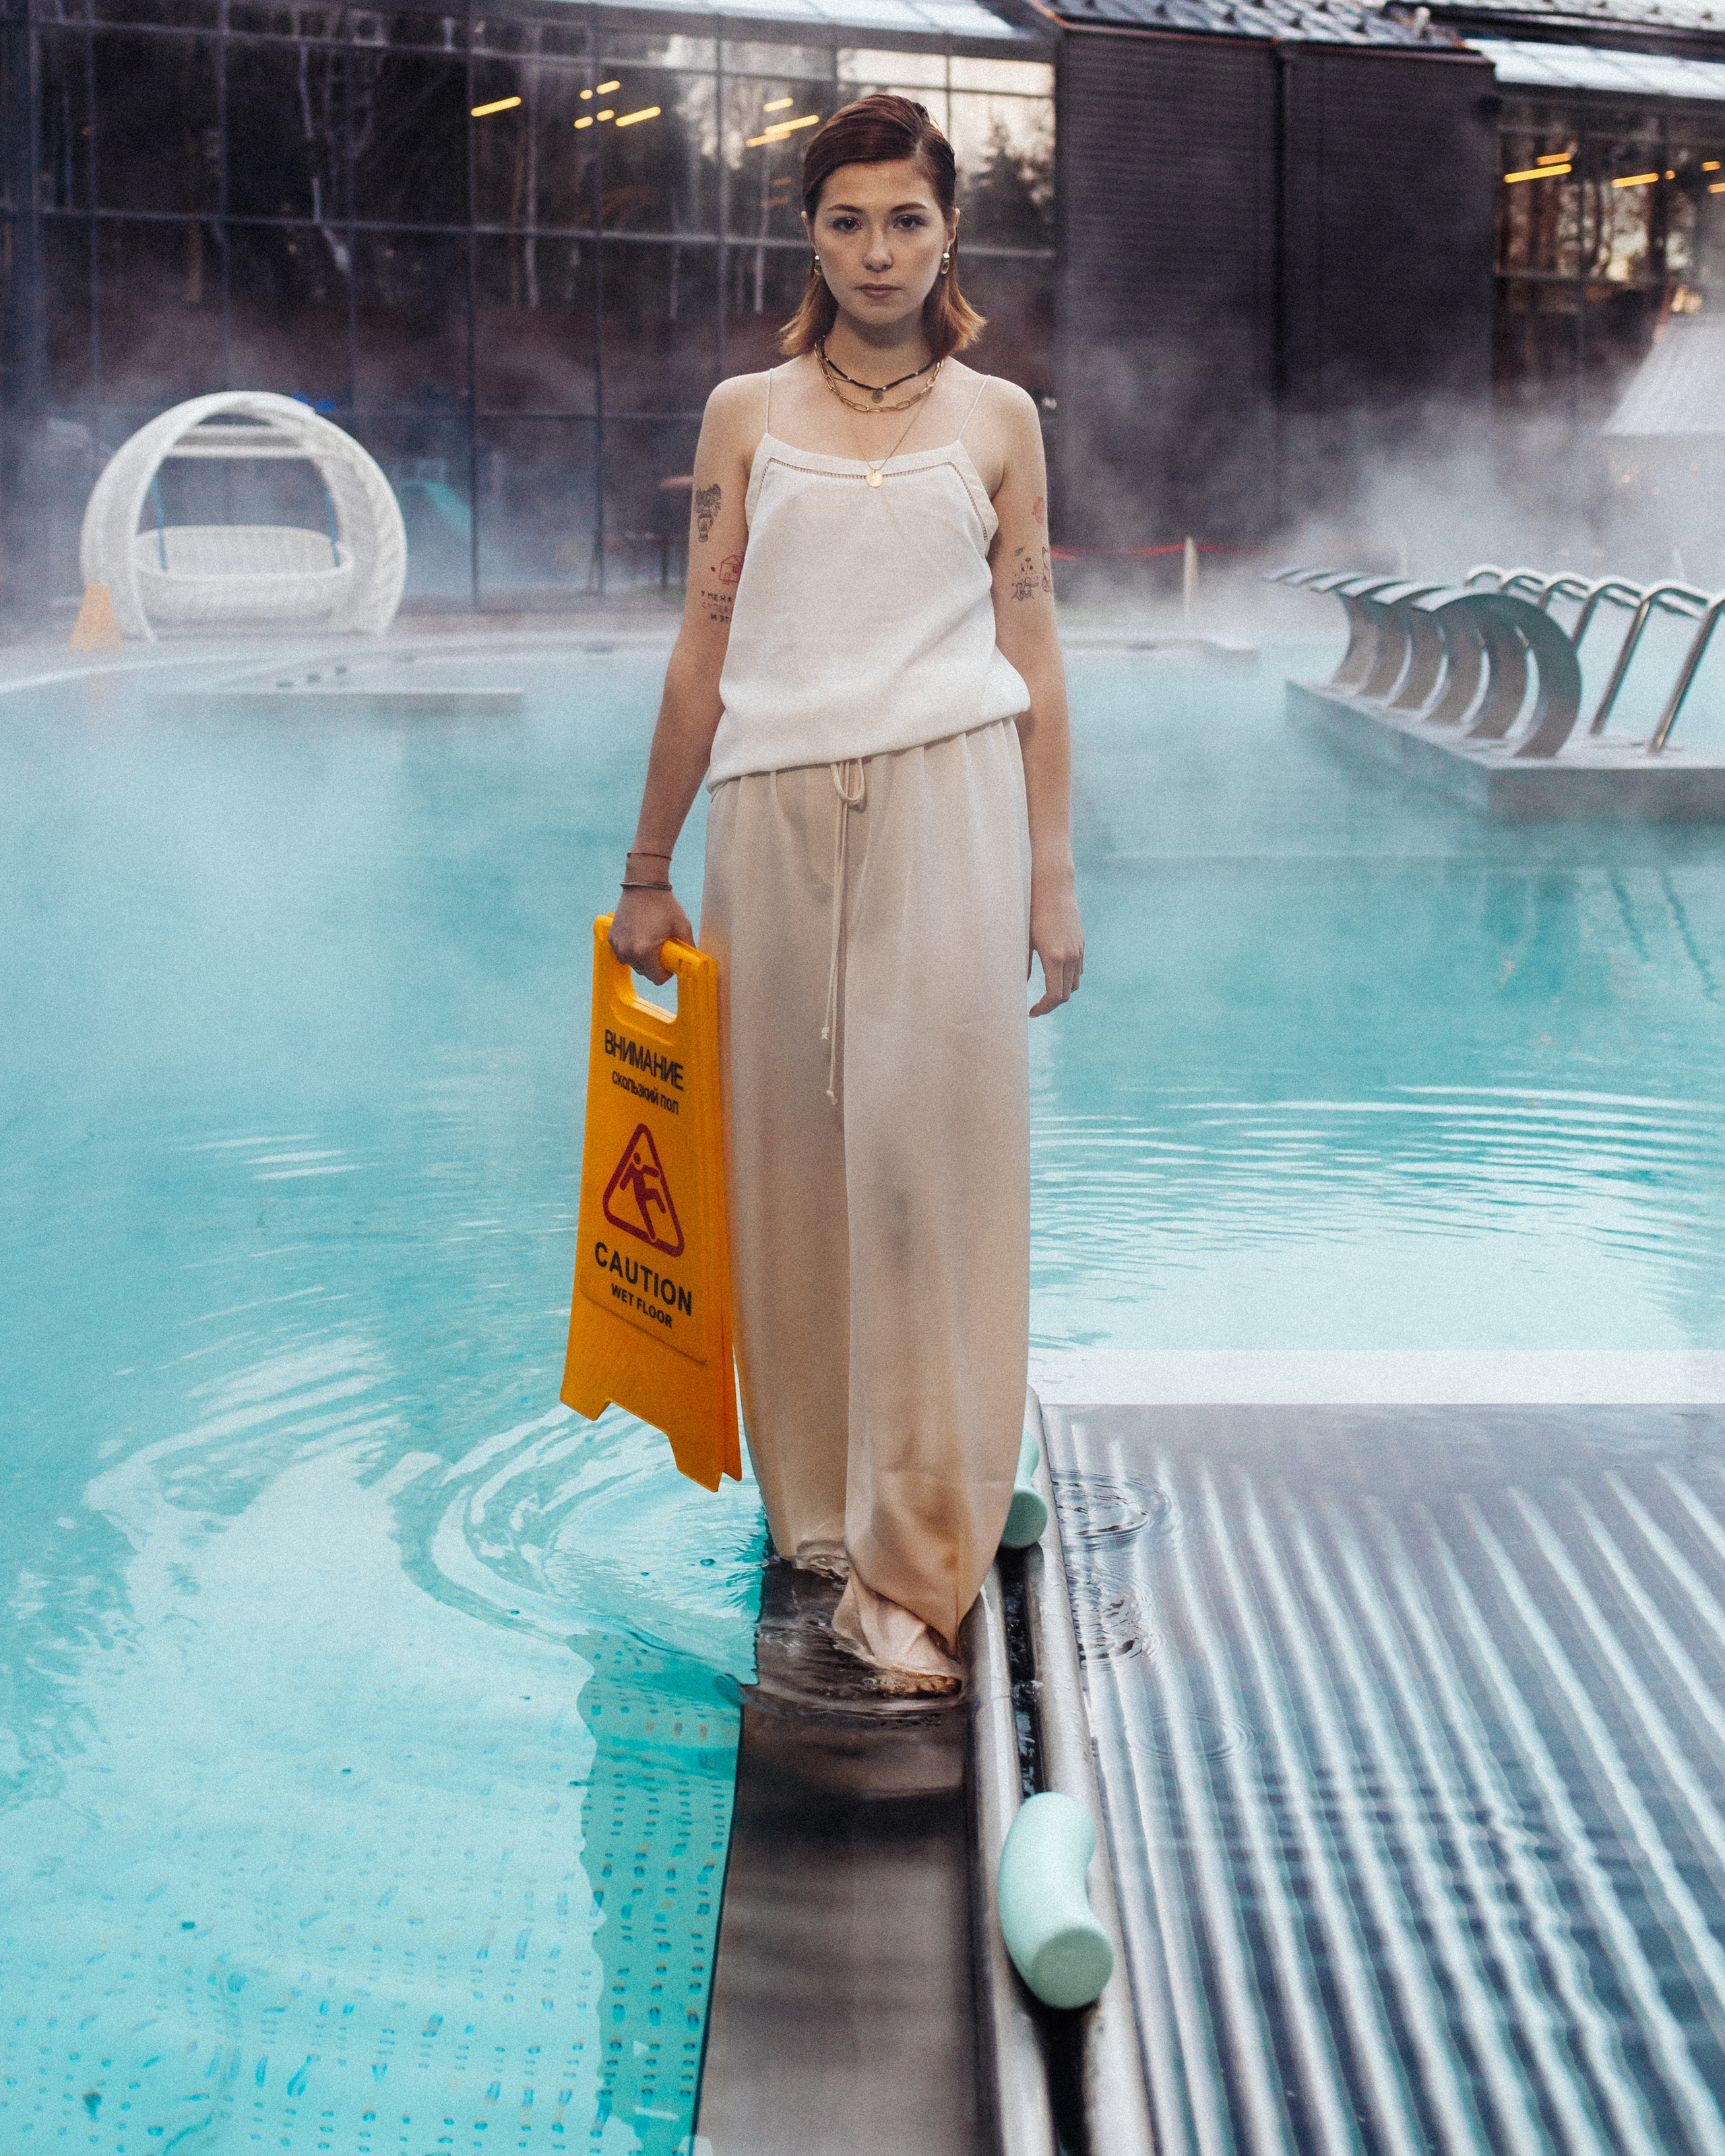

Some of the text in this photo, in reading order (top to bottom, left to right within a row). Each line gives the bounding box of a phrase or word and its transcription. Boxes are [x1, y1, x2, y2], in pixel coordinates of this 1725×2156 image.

[604, 1028, 684, 1091] ВНИМАНИЕ
[595, 1241, 692, 1317] CAUTION
[610, 1282, 672, 1329] WET FLOOR
